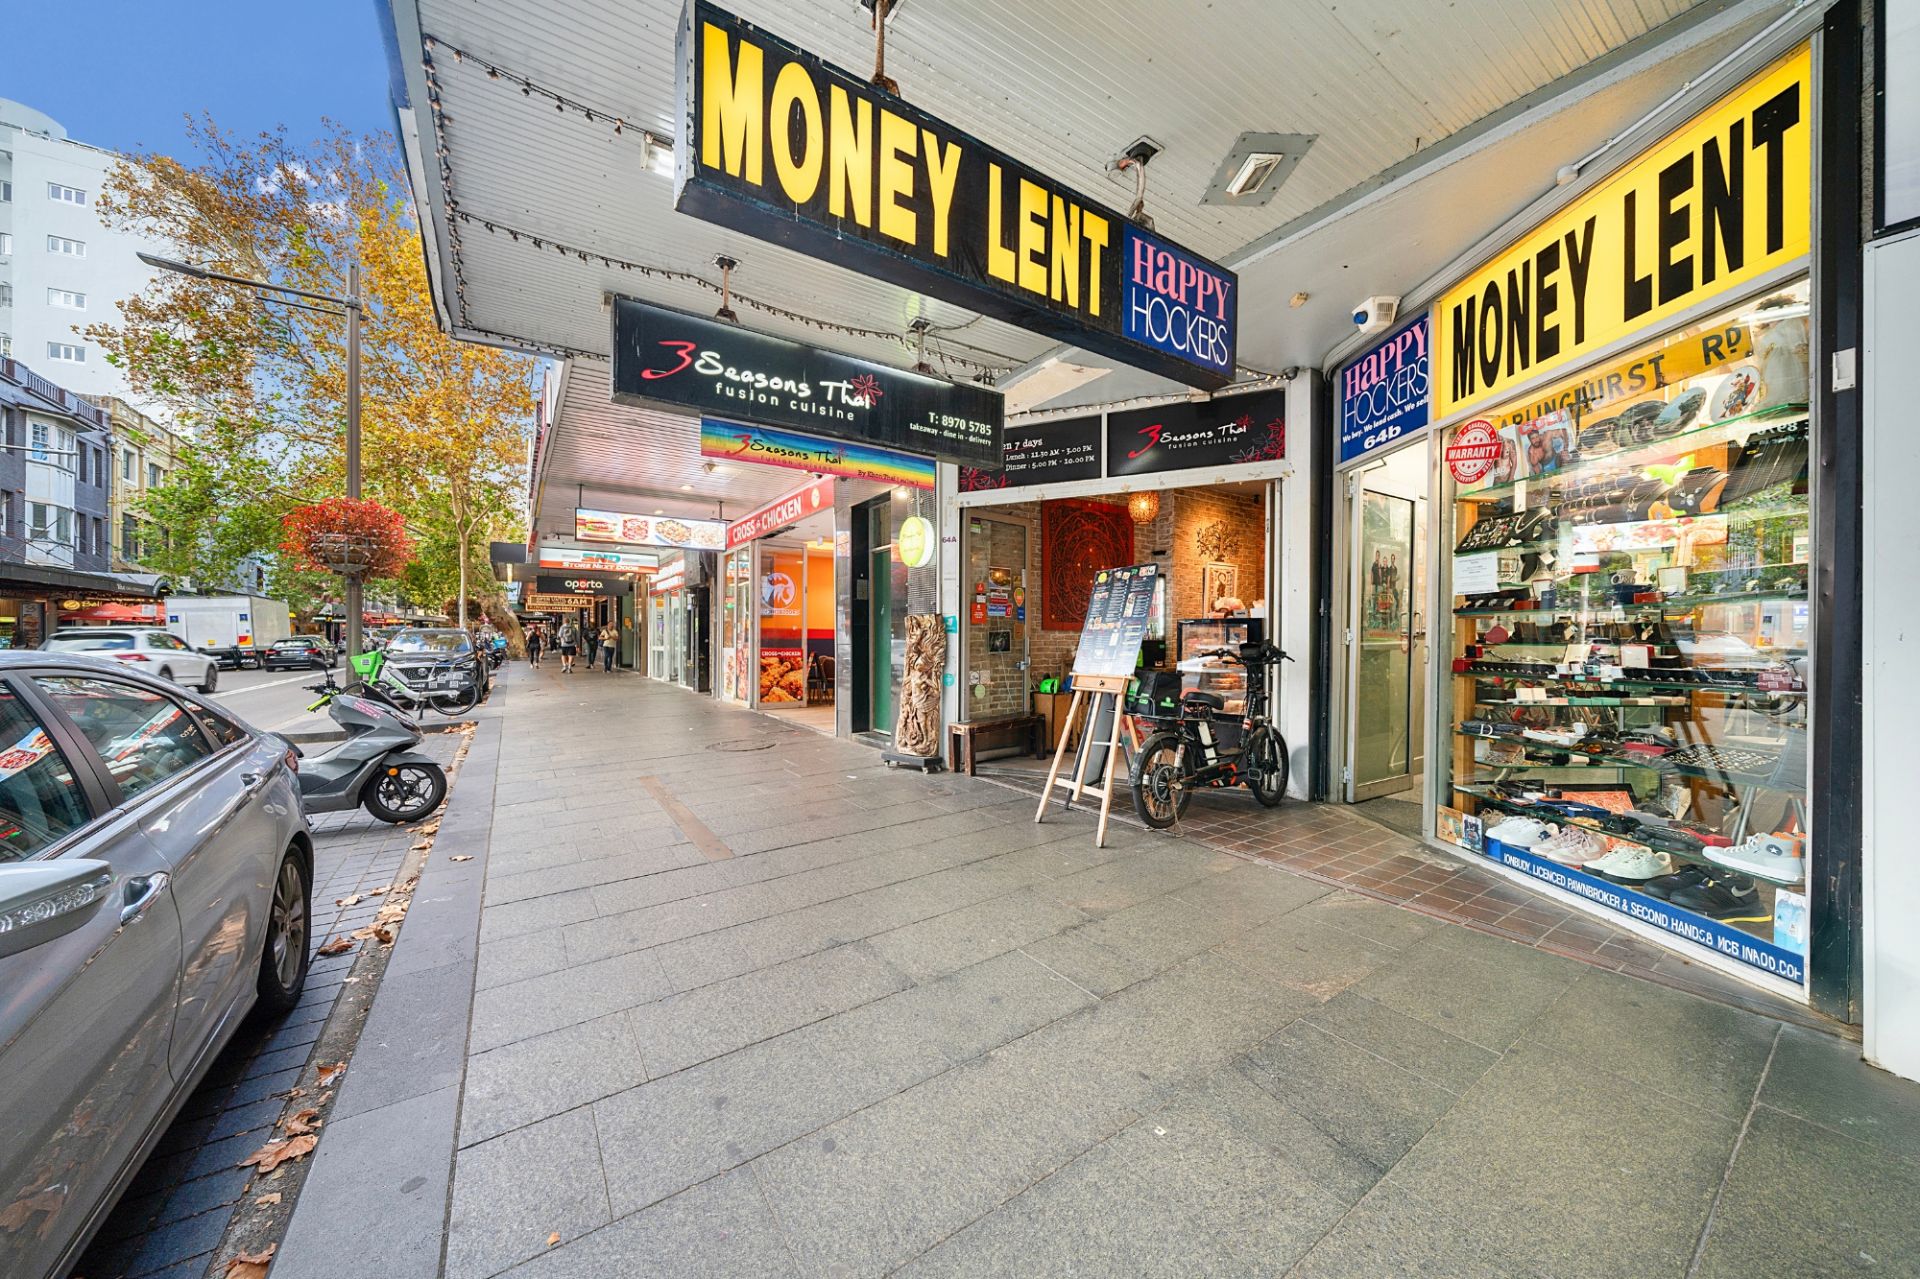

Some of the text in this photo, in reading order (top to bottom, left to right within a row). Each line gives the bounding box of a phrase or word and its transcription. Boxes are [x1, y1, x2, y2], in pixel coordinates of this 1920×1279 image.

[702, 21, 1109, 317] MONEY LENT
[1452, 80, 1800, 403] MONEY LENT
[1132, 287, 1228, 366] HOCKERS
[641, 340, 872, 410] 3 Seasons Thai
[715, 381, 855, 421] fusion cuisine
[1344, 357, 1429, 433] HOCKERS
[909, 422, 938, 436] takeaway
[969, 435, 992, 447] delivery
[928, 411, 992, 436] T: 8970 5785
[1363, 425, 1402, 449] 64b
[750, 438, 809, 459] Seasons
[814, 449, 842, 465] Thai
[1014, 442, 1021, 450] 7
[1022, 438, 1043, 448] days
[1082, 444, 1093, 452] PM
[1127, 422, 1247, 458] 3 Seasons Thai
[1168, 436, 1238, 450] fusion cuisine
[1448, 445, 1498, 460] WARRANTY
[1005, 463, 1027, 472] Dinner
[1085, 455, 1095, 463] PM
[732, 495, 803, 543] CROSS CHICKEN
[565, 580, 603, 589] oporto
[1567, 878, 1621, 909] PAWNBROKER
[1630, 902, 1669, 927] SECOND
